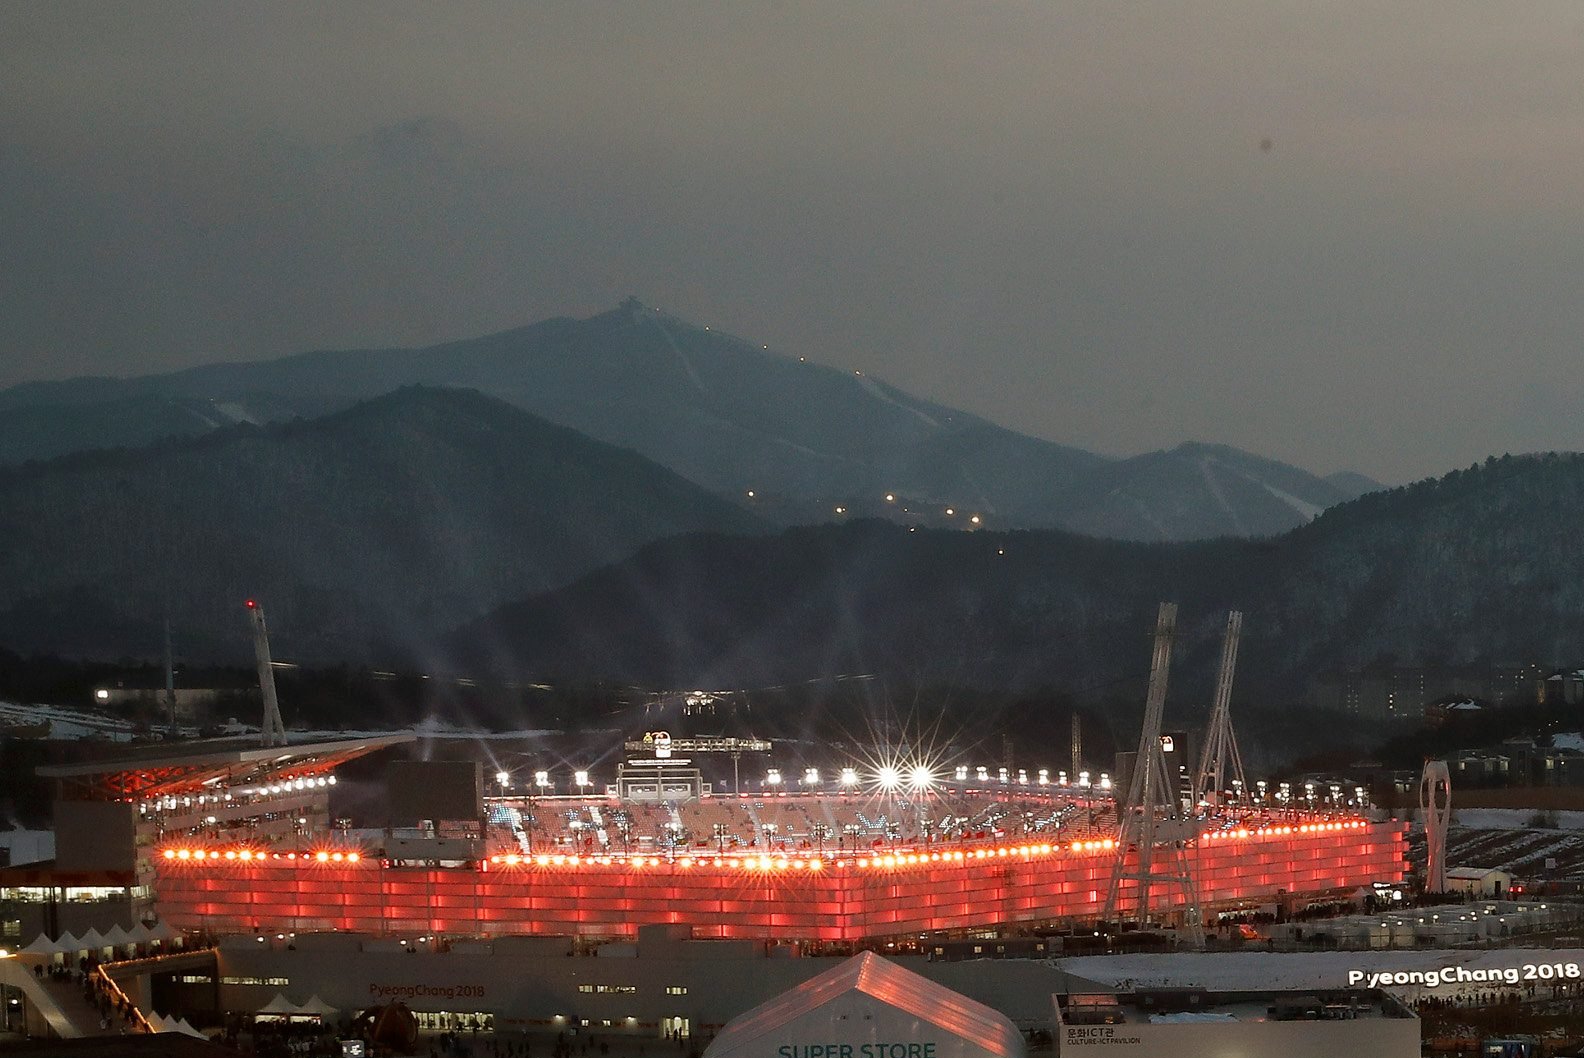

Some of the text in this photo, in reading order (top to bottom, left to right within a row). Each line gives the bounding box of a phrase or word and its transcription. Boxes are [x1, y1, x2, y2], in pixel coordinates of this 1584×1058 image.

[1348, 963, 1581, 988] PyeongChang 2018
[369, 983, 485, 999] PyeongChang 2018
